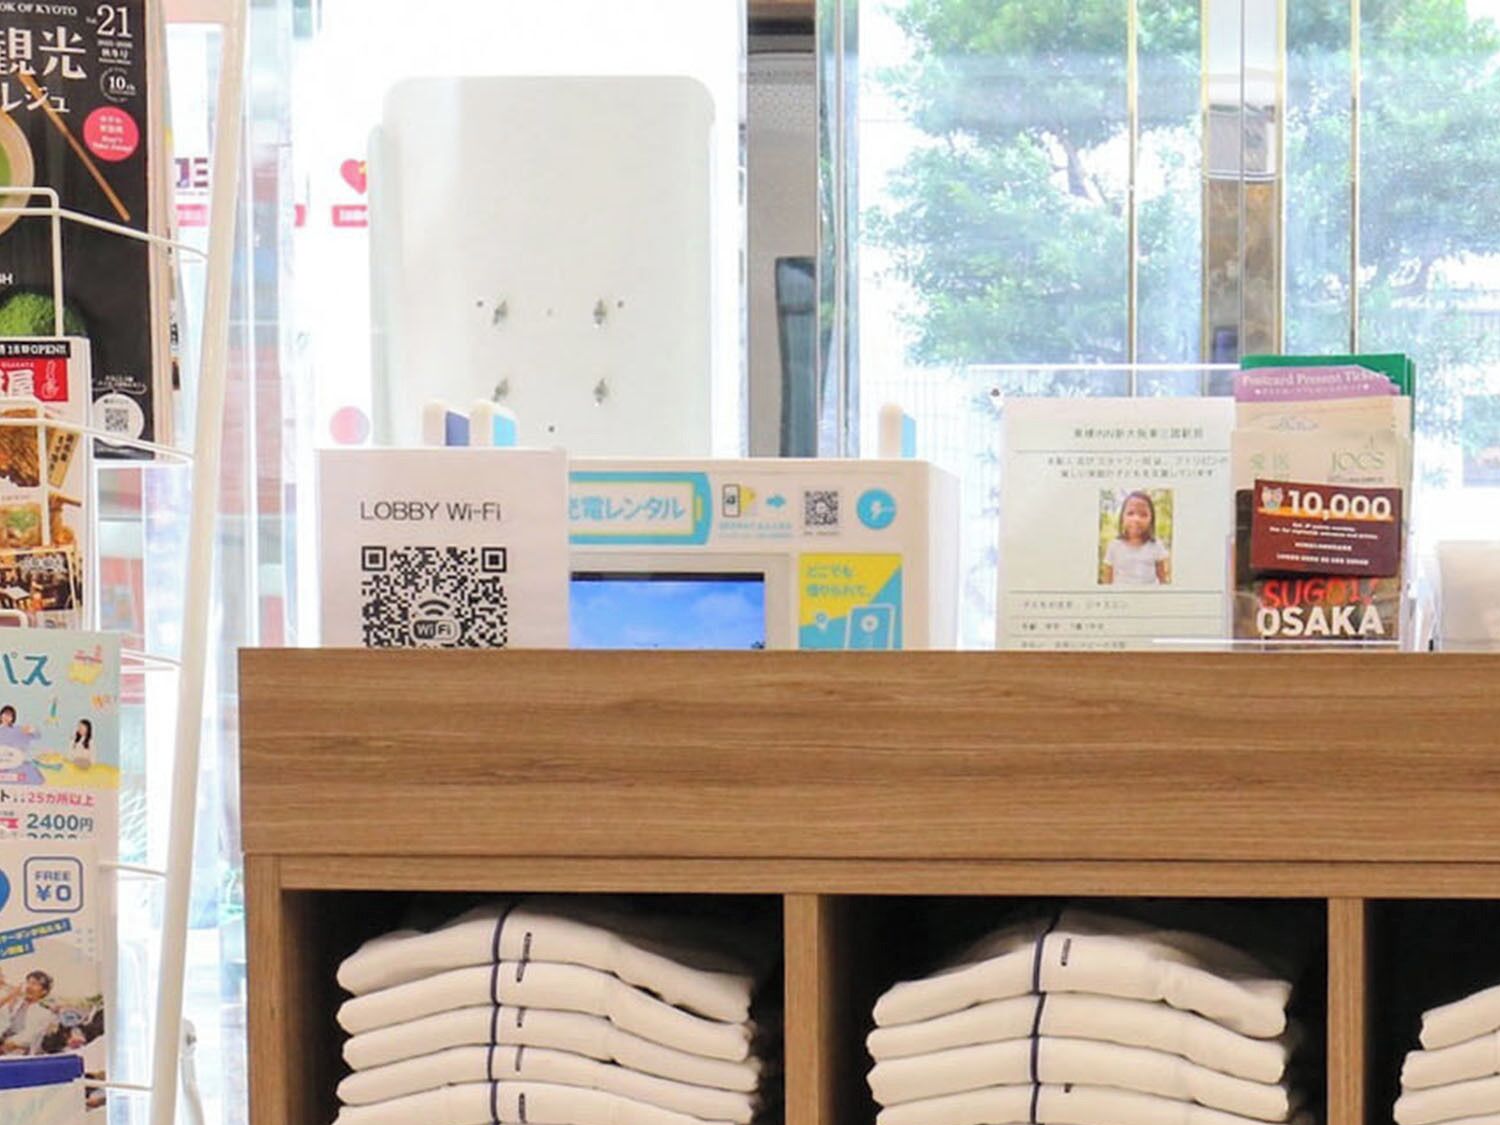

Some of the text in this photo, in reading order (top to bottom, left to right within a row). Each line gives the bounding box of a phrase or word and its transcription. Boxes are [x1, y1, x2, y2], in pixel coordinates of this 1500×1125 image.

[36, 4, 78, 16] KYOTO
[97, 4, 133, 38] 21
[360, 501, 501, 521] LOBBY Wi-Fi
[1287, 490, 1391, 520] 10,000
[1256, 605, 1384, 636] OSAKA
[26, 813, 94, 832] 2400円
[35, 870, 71, 882] FREE
